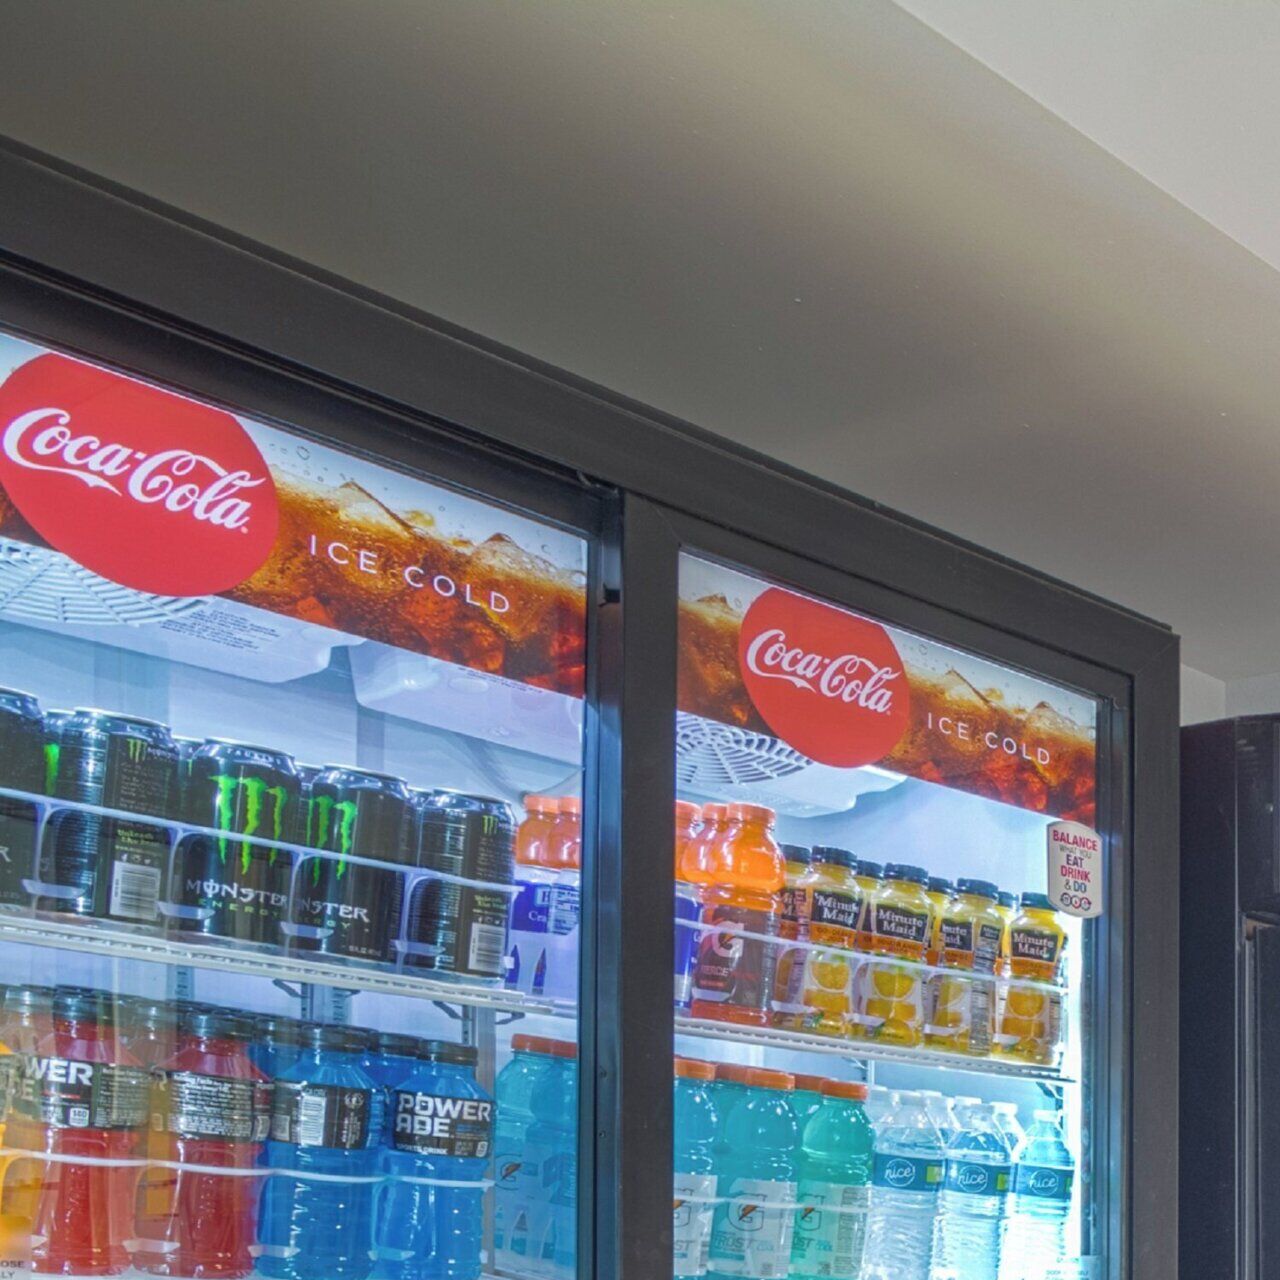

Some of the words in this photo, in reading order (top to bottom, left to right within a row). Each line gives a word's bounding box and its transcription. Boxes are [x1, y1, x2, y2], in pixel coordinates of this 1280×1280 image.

[2, 407, 267, 532] Coca-Cola
[309, 534, 378, 575] ICE
[404, 566, 511, 613] COLD
[746, 628, 901, 714] Coca-Cola
[927, 712, 968, 741] ICE
[986, 731, 1051, 766] COLD
[1053, 830, 1098, 851] BALANCE
[1066, 854, 1084, 868] EAT
[1061, 865, 1091, 883] DRINK
[1073, 881, 1087, 894] DO
[302, 897, 370, 924] NSTER
[879, 909, 923, 927] Minute
[883, 921, 917, 936] Maid
[1014, 932, 1054, 948] Minute
[1018, 943, 1049, 958] Maid
[23, 1056, 95, 1087] WER
[399, 1093, 492, 1122] POWER
[396, 1113, 452, 1138] ADE
